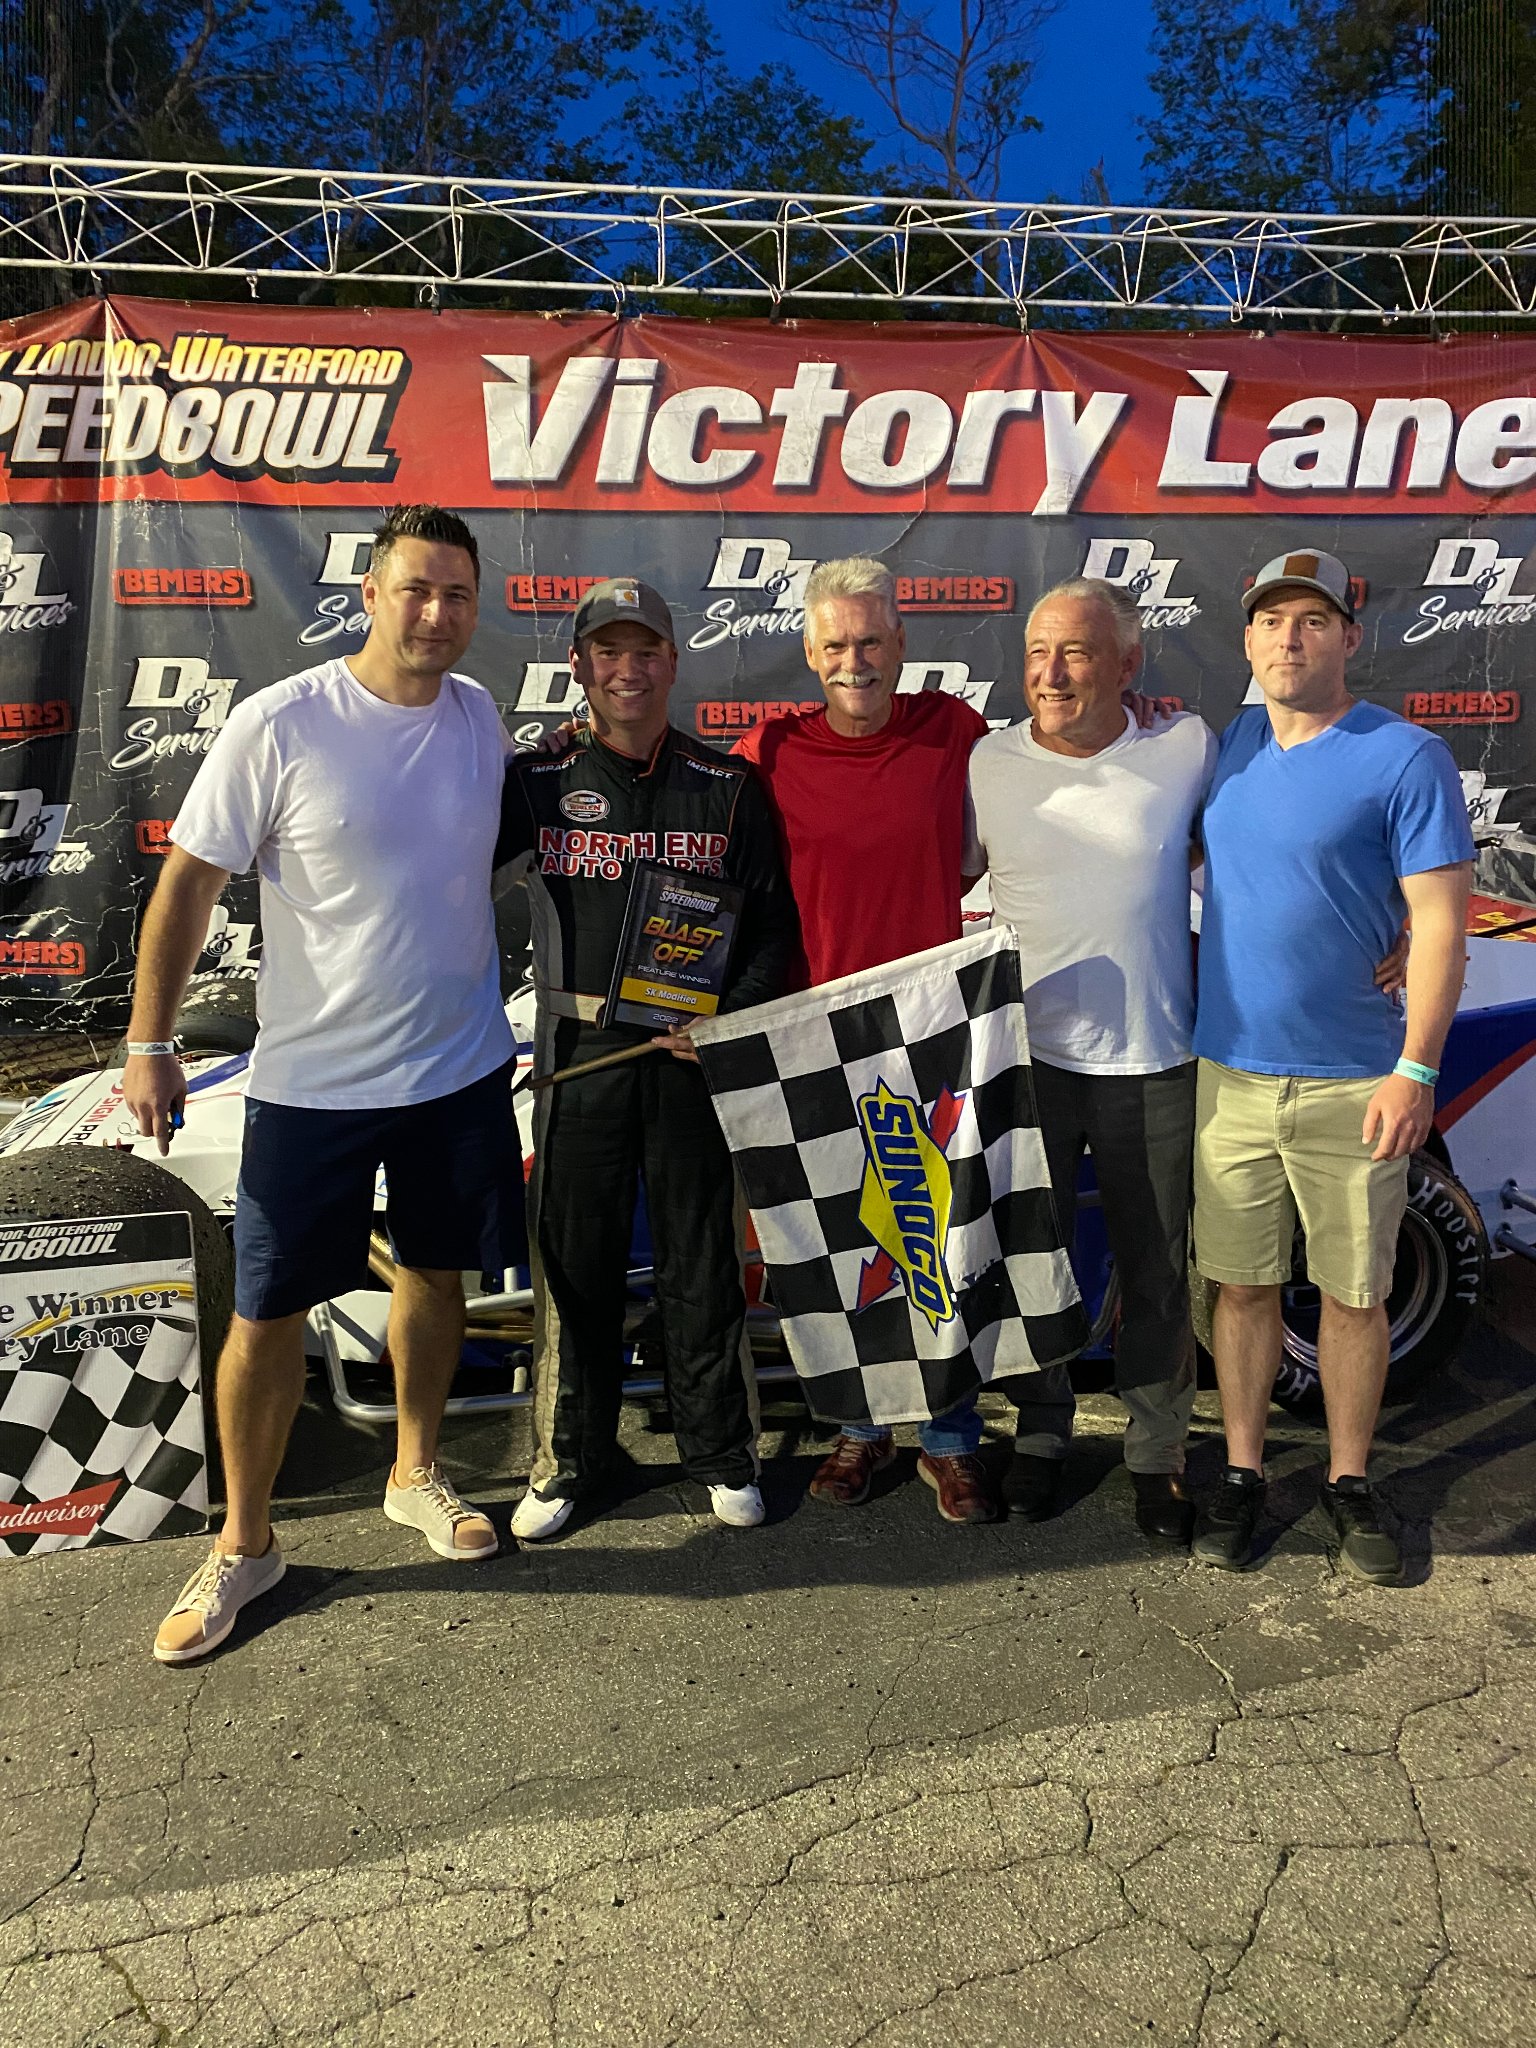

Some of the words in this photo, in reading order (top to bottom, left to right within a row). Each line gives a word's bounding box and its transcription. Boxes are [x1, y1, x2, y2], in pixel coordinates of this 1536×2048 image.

[481, 354, 1129, 516] Victory
[1158, 369, 1536, 489] Lane
[124, 568, 241, 595] BEMERS
[1081, 538, 1195, 607] D&L
[1422, 538, 1536, 605] D&L
[516, 575, 608, 600] BEME
[895, 576, 1005, 600] BEMERS
[1402, 595, 1536, 645] Services
[0, 701, 61, 727] ERS
[1412, 691, 1511, 714] BEMERS
[531, 756, 577, 773] IMPACT
[686, 759, 733, 779] IMPACT
[539, 827, 656, 862] NORTH
[664, 831, 729, 859] END
[540, 853, 622, 881] AUTO
[659, 890, 717, 913] SPEEDBOWL
[642, 915, 723, 949] BLAST
[653, 942, 704, 967] OFF
[637, 964, 677, 978] FEATURE
[678, 973, 711, 985] WINNER
[644, 987, 657, 997] SK
[658, 989, 697, 1005] Modified
[652, 1013, 679, 1024] 2022
[84, 1096, 124, 1123] SIGN
[874, 1099, 945, 1313] SUNOCO
[0, 1222, 124, 1241] ON-WATERFORD
[0, 1233, 117, 1263] DBOWL
[26, 1288, 179, 1322] Winner
[53, 1324, 150, 1354] Lane
